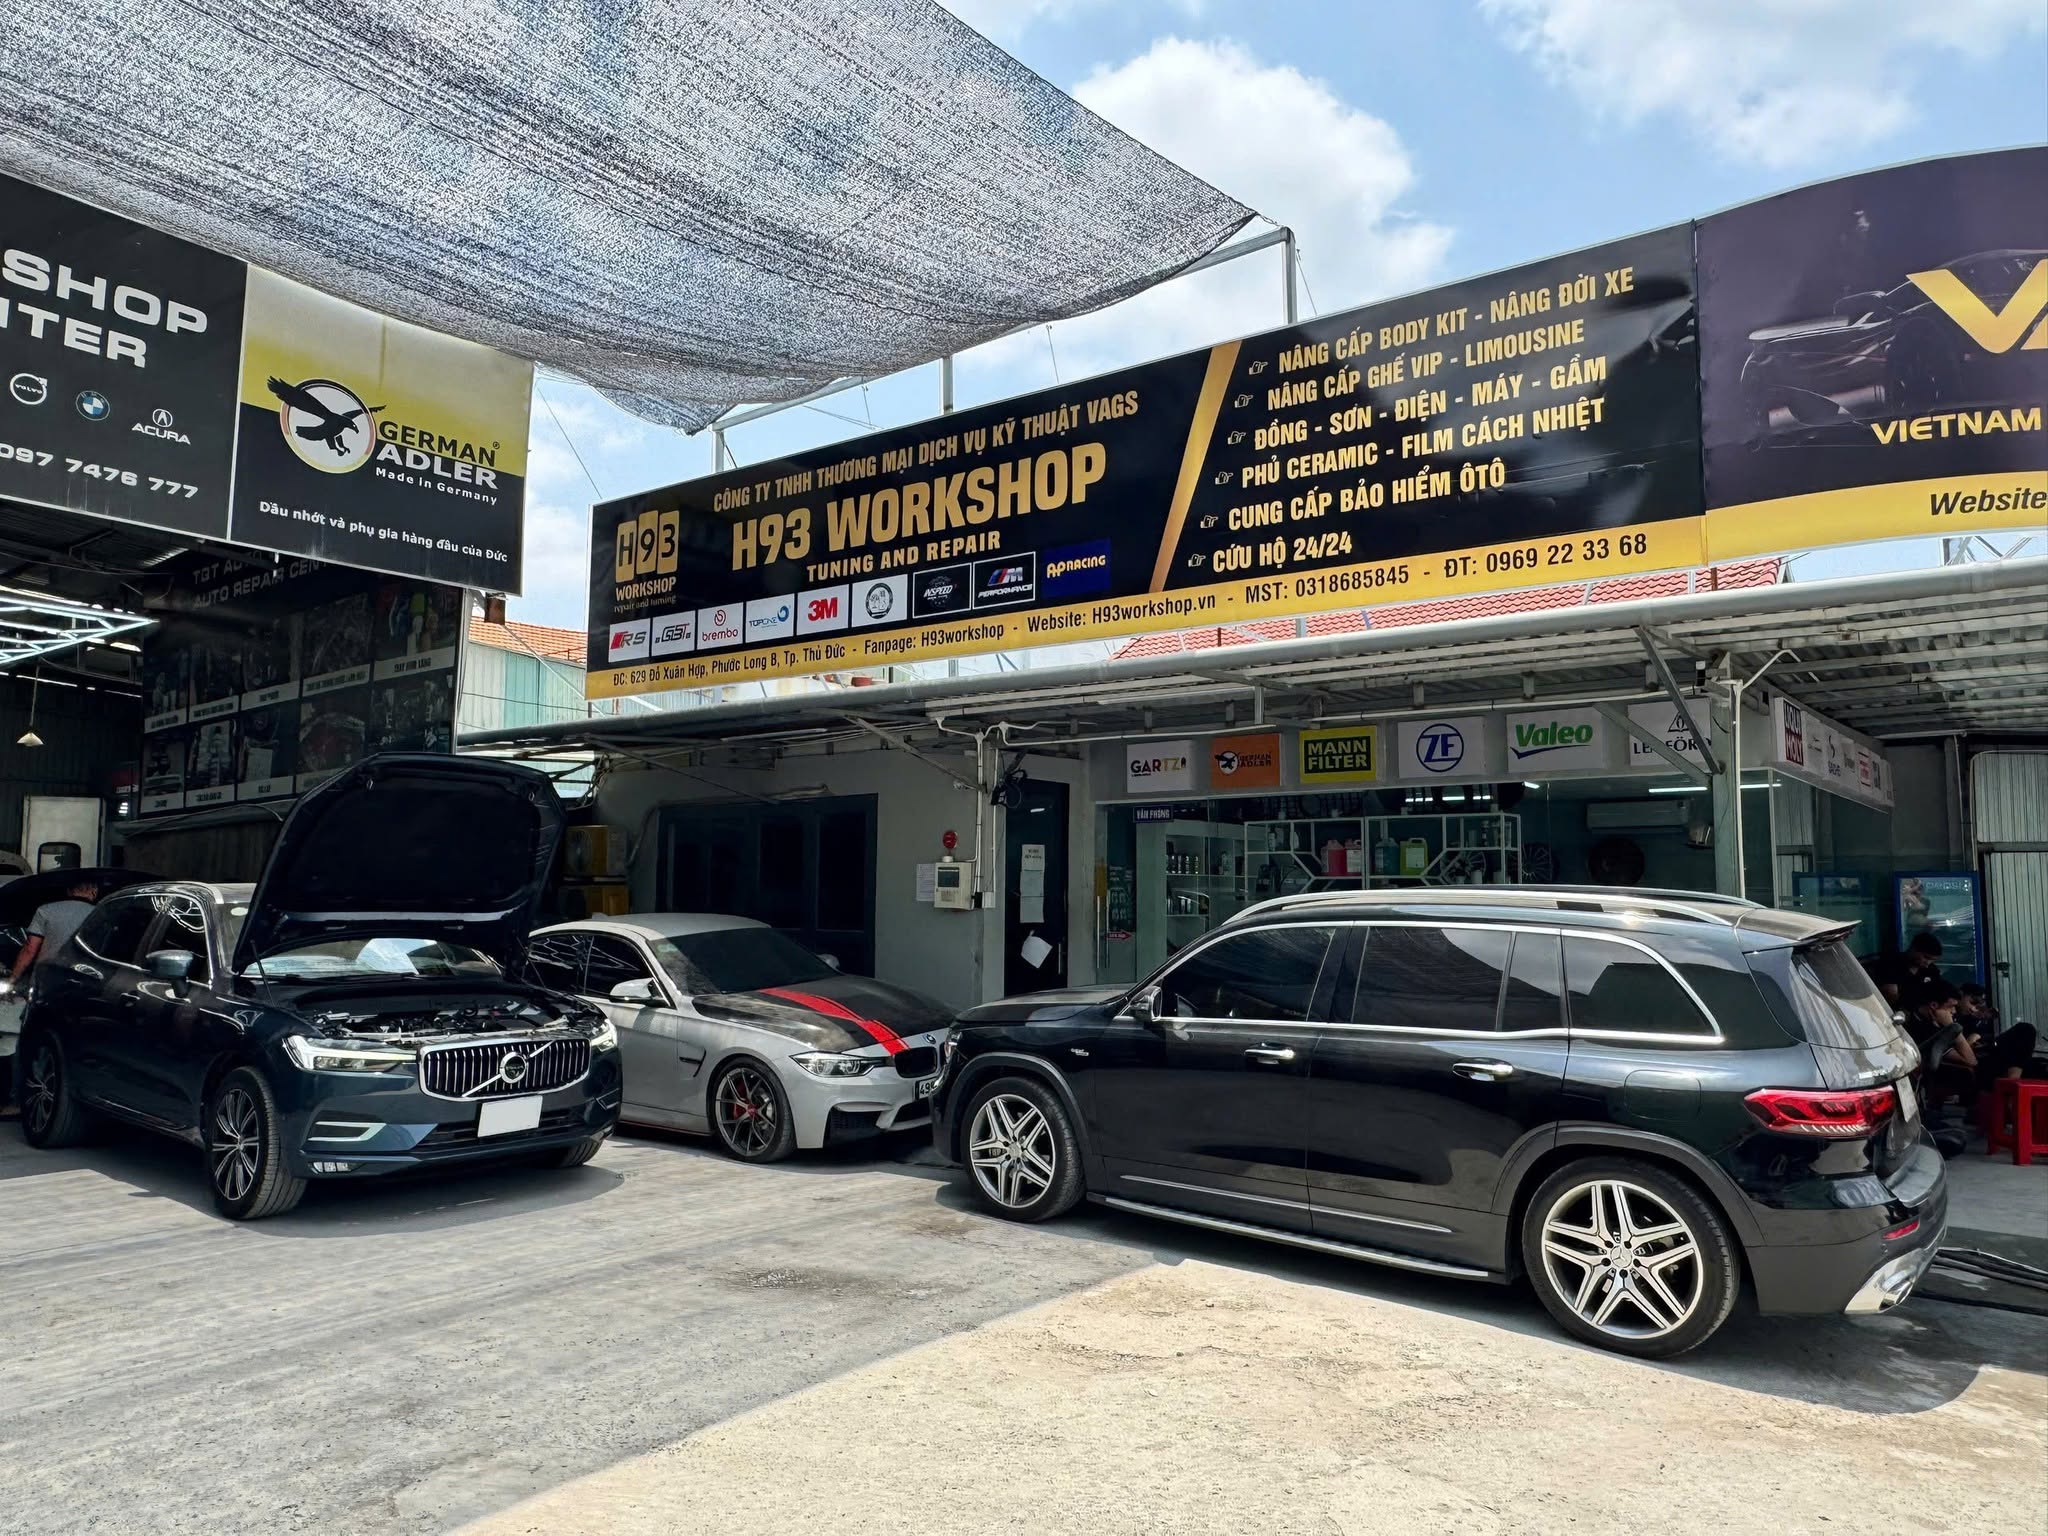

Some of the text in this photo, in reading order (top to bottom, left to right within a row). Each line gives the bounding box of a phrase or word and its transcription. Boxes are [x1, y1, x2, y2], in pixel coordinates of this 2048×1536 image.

[2, 249, 207, 333] SHOP
[1906, 258, 2048, 353] V
[1279, 344, 1329, 373] NÂNG
[1335, 326, 1373, 360] CẤP
[1380, 317, 1429, 350] BODY
[1437, 308, 1467, 336] KIT
[1490, 287, 1550, 323] NÂNG
[1559, 273, 1596, 308] ĐỜI
[1605, 266, 1634, 297] XE
[1268, 382, 1318, 411] NÂNG
[1324, 366, 1361, 398] CẤP
[1367, 353, 1405, 388] GHẾ
[1411, 351, 1443, 379] VIP
[1465, 319, 1585, 367] LIMOUSINE
[1254, 418, 1308, 450] ĐỒNG
[1329, 404, 1372, 435] SƠN
[1395, 389, 1447, 423] ĐIỆN
[1472, 373, 1523, 407] MÁY
[1550, 354, 1607, 391] GẦM
[132, 423, 191, 445] ACURA
[1242, 455, 1280, 488] PHỦ
[1286, 442, 1378, 480] CERAMIC
[1402, 427, 1453, 459] FILM
[1461, 413, 1524, 448] CÁCH
[1533, 396, 1605, 435] NHIỆT
[1870, 407, 2042, 444] VIETNAM
[0, 443, 199, 499] 097 7476 777
[376, 443, 498, 489] ADLER
[713, 391, 1139, 512] CÔNG TY TNHH THƯƠNG MẠI DỊCH VỤ KỸ THUẬT VAGS
[376, 467, 414, 484] Made
[437, 482, 497, 505] Germany
[732, 442, 1107, 571] H93 WORKSHOP
[1228, 457, 1505, 531] CUNG CẤP BẢO HIỂM ÔTÔ
[1929, 487, 2048, 516] Website
[402, 531, 433, 549] hàng
[486, 549, 508, 562] Đức
[618, 518, 677, 573] H93
[807, 531, 1001, 582] TUNING AND REPAIR
[1212, 530, 1352, 573] CỨU HỘ 24/24
[613, 672, 628, 686] ĐC:
[630, 670, 646, 684] 629
[743, 656, 767, 671] Long
[770, 652, 780, 668] B,
[784, 650, 799, 667] Tp.
[803, 645, 822, 662] Thủ
[825, 643, 845, 659] Đức
[864, 635, 917, 656] Fanpage:
[921, 623, 1005, 648] H93workshop
[1027, 612, 1087, 633] Website:
[1092, 594, 1216, 624] H93workshop.vn
[1245, 581, 1288, 604] MST:
[1296, 564, 1409, 597] 0318685845
[1444, 556, 1477, 578] ĐT:
[1486, 547, 1538, 572] 0969
[1547, 543, 1573, 565] 22
[1582, 538, 1609, 561] 33
[1619, 533, 1647, 556] 68
[615, 576, 677, 602] WORKSHOP
[808, 597, 838, 621] 3M
[702, 628, 739, 641] brembo
[1308, 740, 1367, 755] MANN
[1420, 734, 1461, 763] ZF
[1515, 722, 1594, 747] Valeo
[1308, 754, 1368, 770] FILTER
